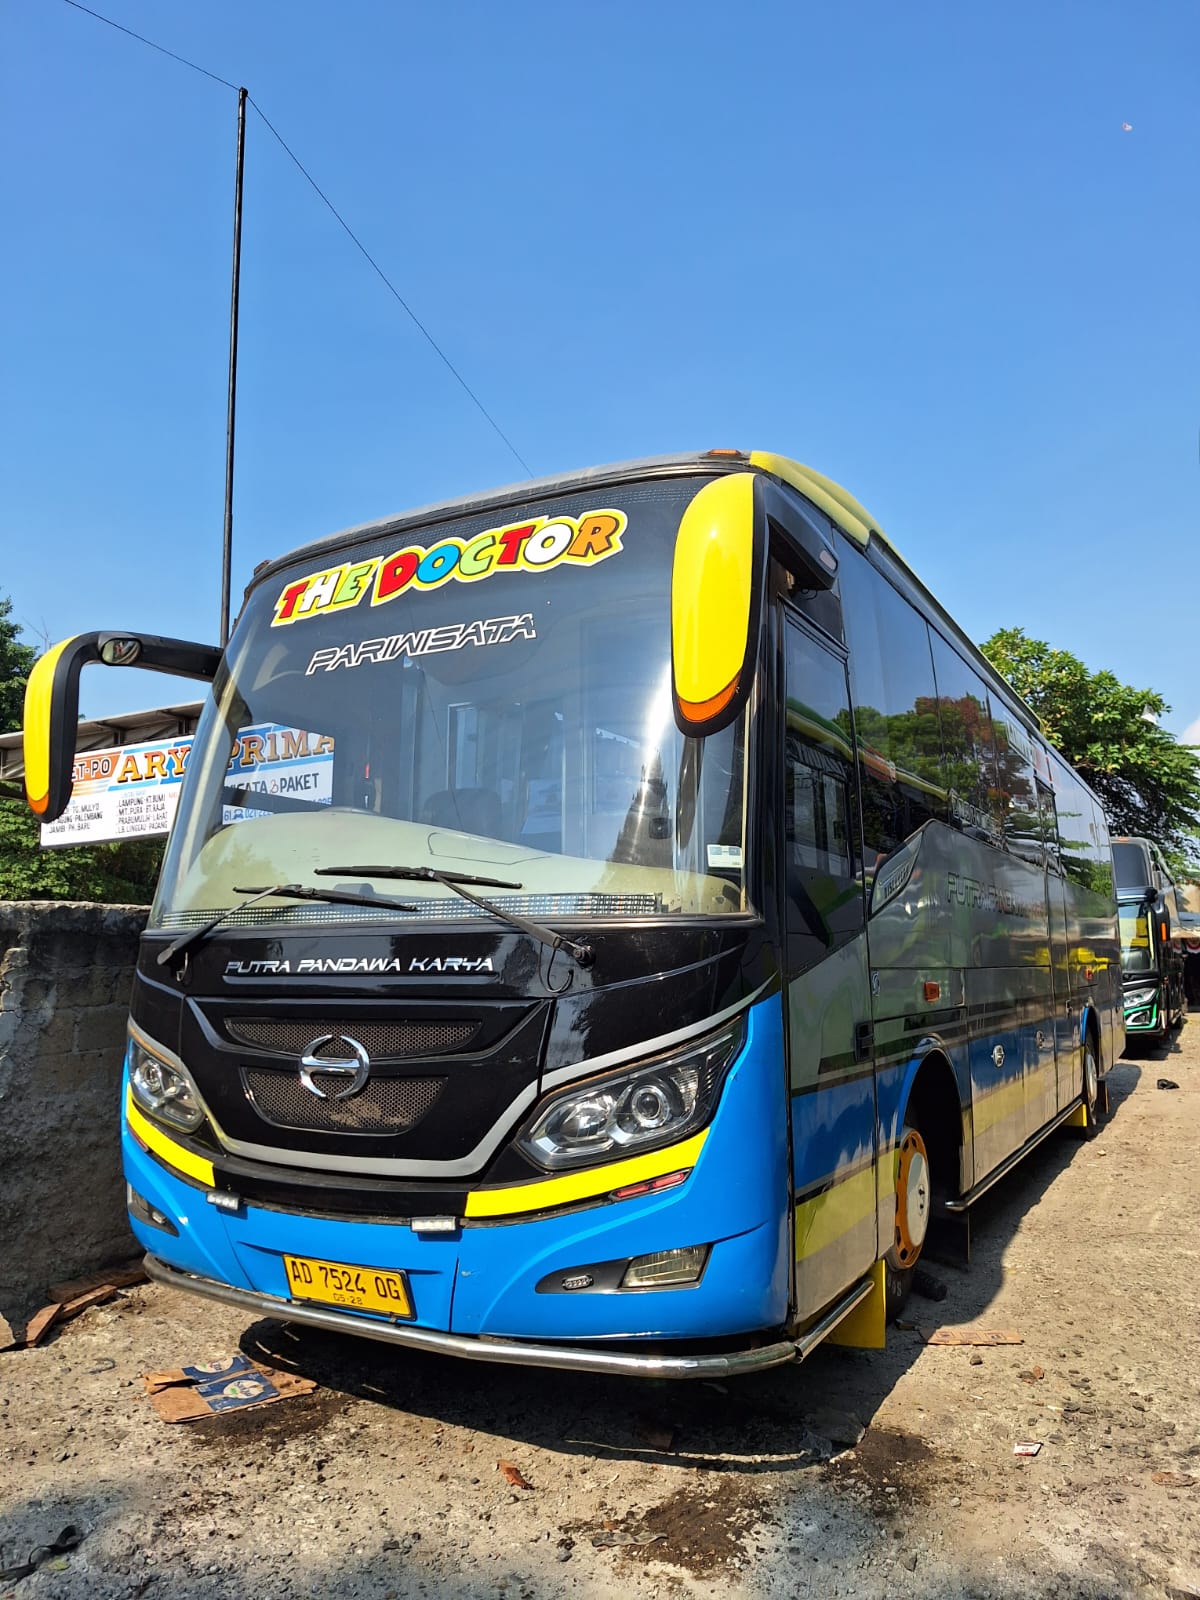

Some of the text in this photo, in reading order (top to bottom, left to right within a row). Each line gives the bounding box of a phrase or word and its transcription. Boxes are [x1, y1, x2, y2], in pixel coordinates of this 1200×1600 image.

[275, 513, 622, 622] THE DOCTOR
[305, 613, 537, 676] PARIWISATA
[117, 746, 192, 783] ARY
[280, 773, 319, 793] PAKET
[225, 957, 494, 973] PUTRA PANDAWA KARYA
[291, 1260, 313, 1284] AD
[319, 1266, 366, 1294] 7524
